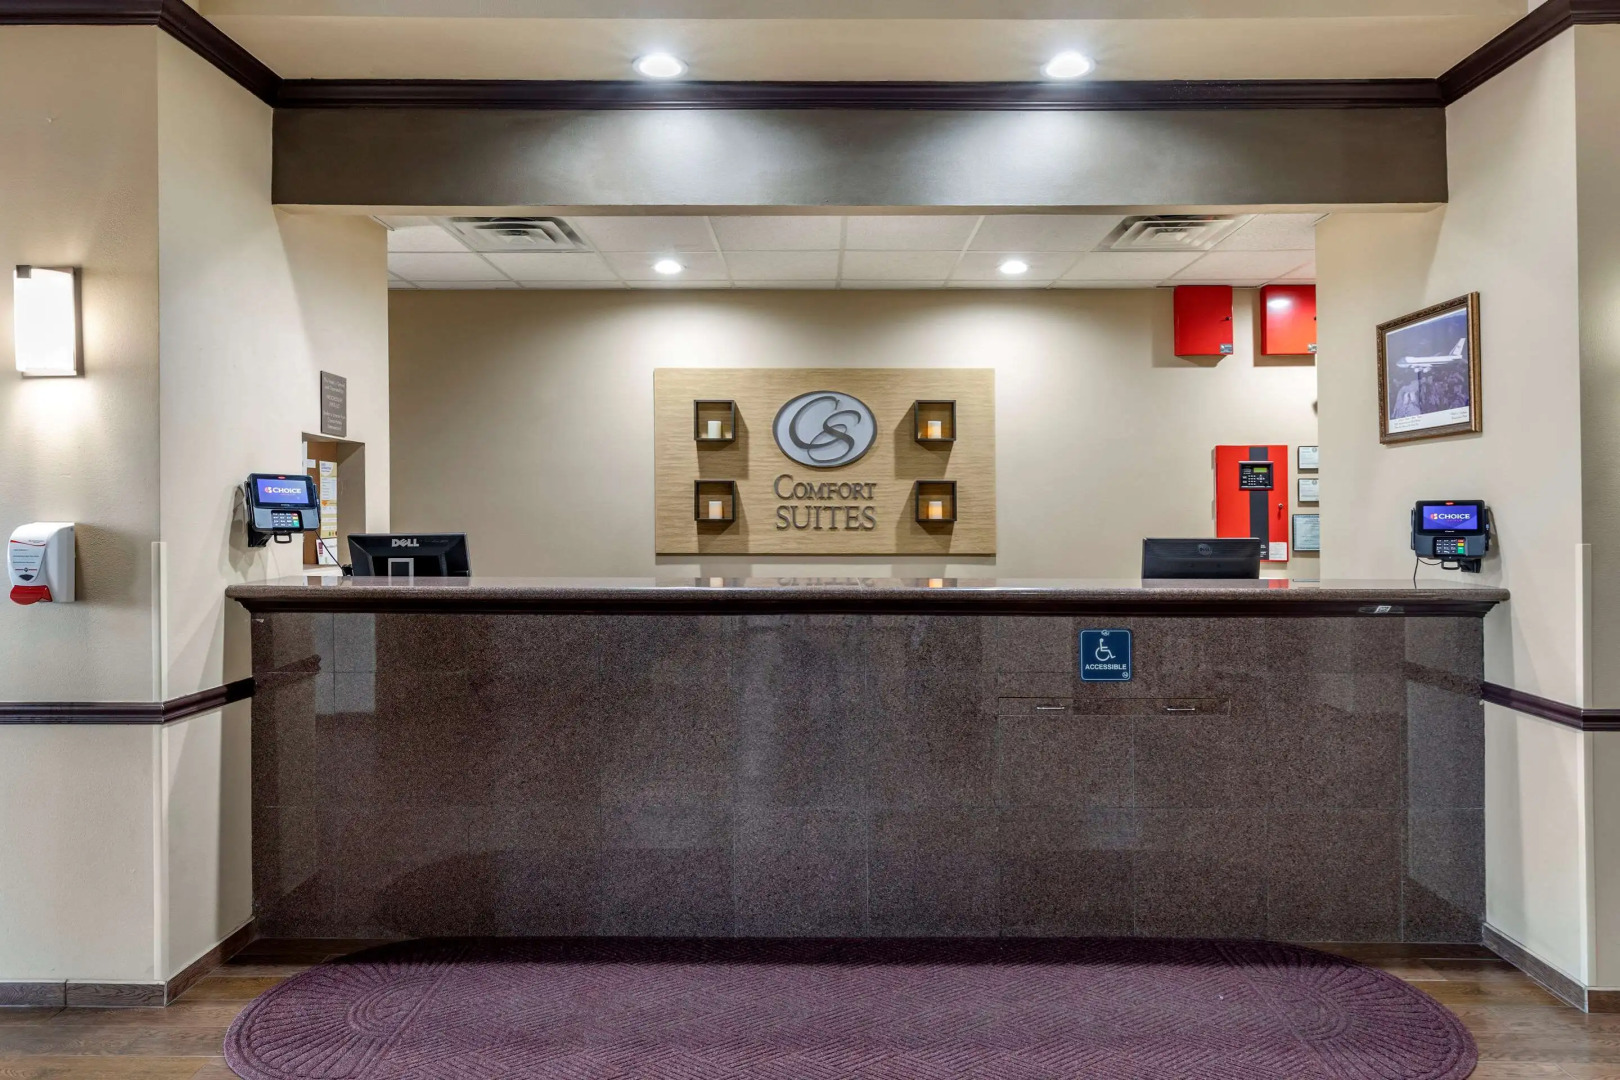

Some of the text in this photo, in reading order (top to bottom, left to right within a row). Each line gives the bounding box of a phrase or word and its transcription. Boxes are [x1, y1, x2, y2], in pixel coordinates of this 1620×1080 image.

[272, 486, 302, 494] CHOICE
[774, 474, 877, 500] COMFORT
[776, 505, 877, 531] SUITES
[391, 538, 420, 547] DELL
